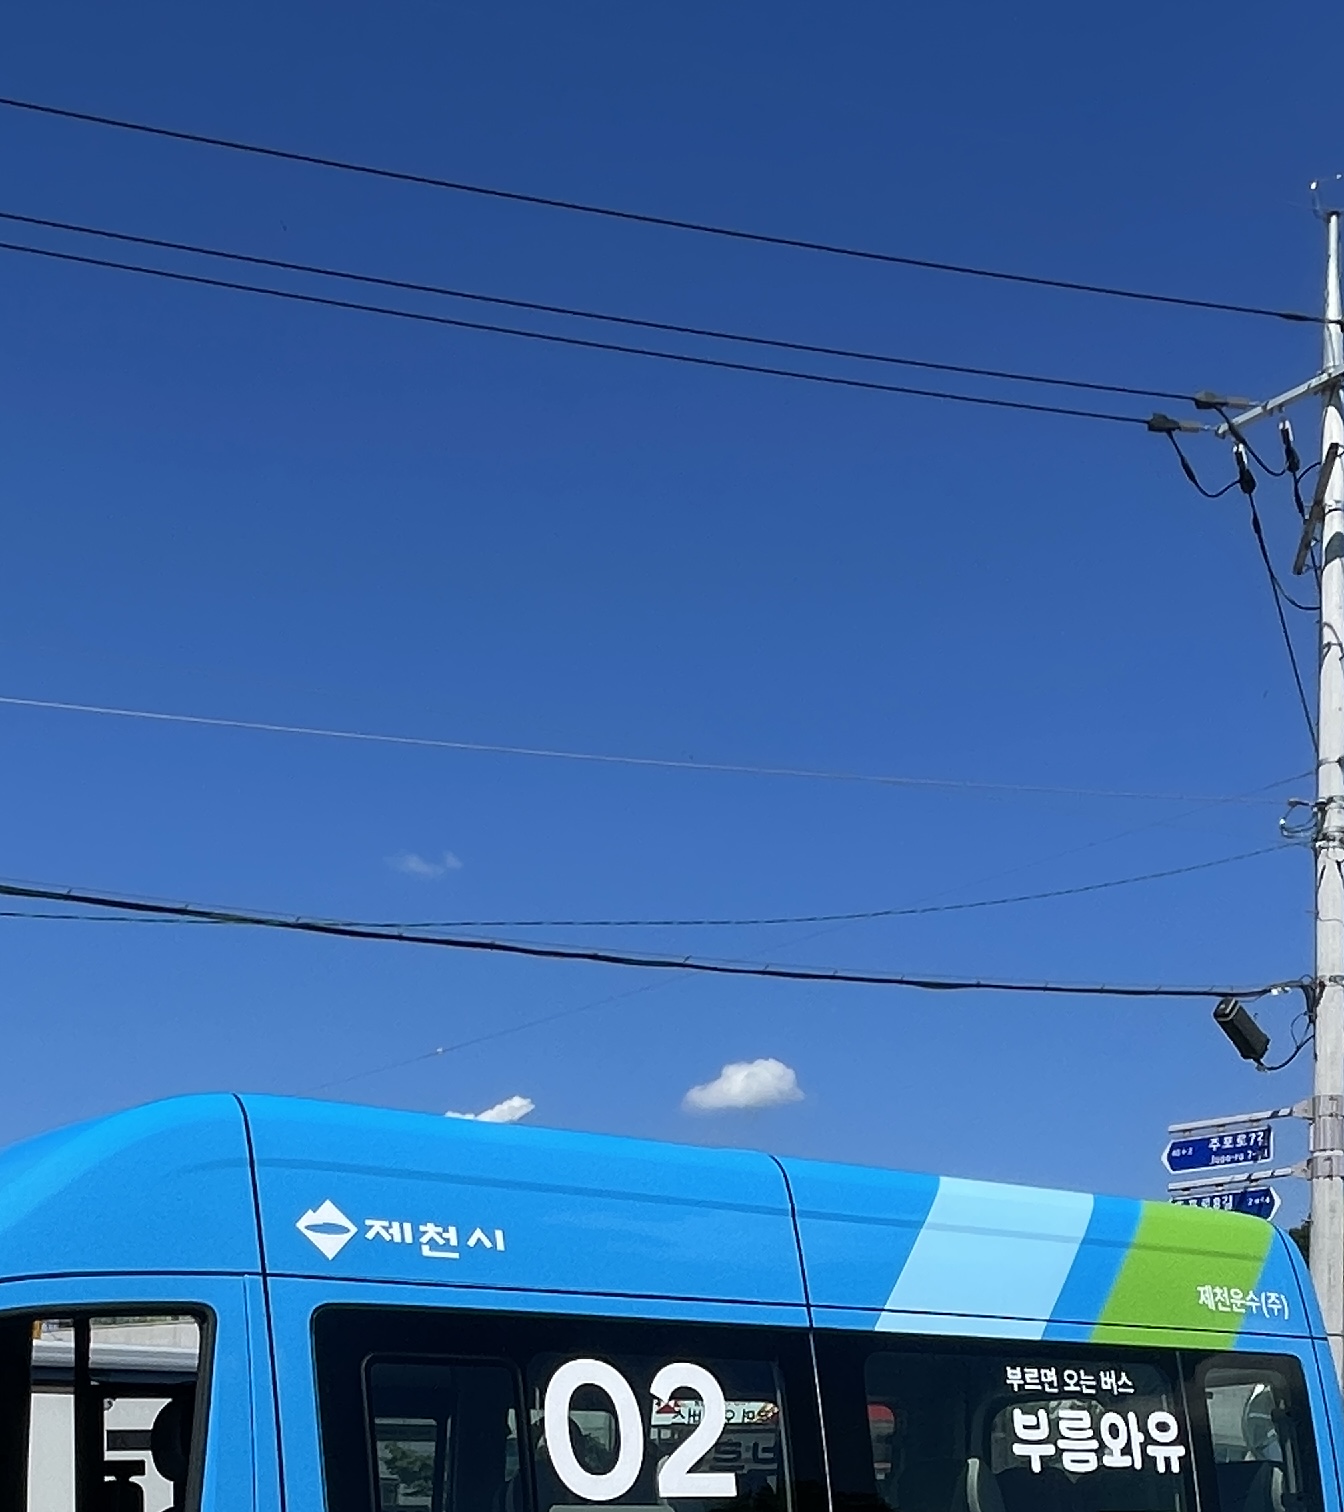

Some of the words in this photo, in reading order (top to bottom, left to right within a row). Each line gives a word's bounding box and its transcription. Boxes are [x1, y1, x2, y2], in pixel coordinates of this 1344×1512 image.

[364, 1218, 505, 1259] 제천시
[1197, 1285, 1289, 1320] 제천운수(주)
[1006, 1366, 1059, 1393] 부르면
[1063, 1369, 1096, 1394] 오는
[1099, 1370, 1135, 1395] 버스
[544, 1358, 737, 1501] 02
